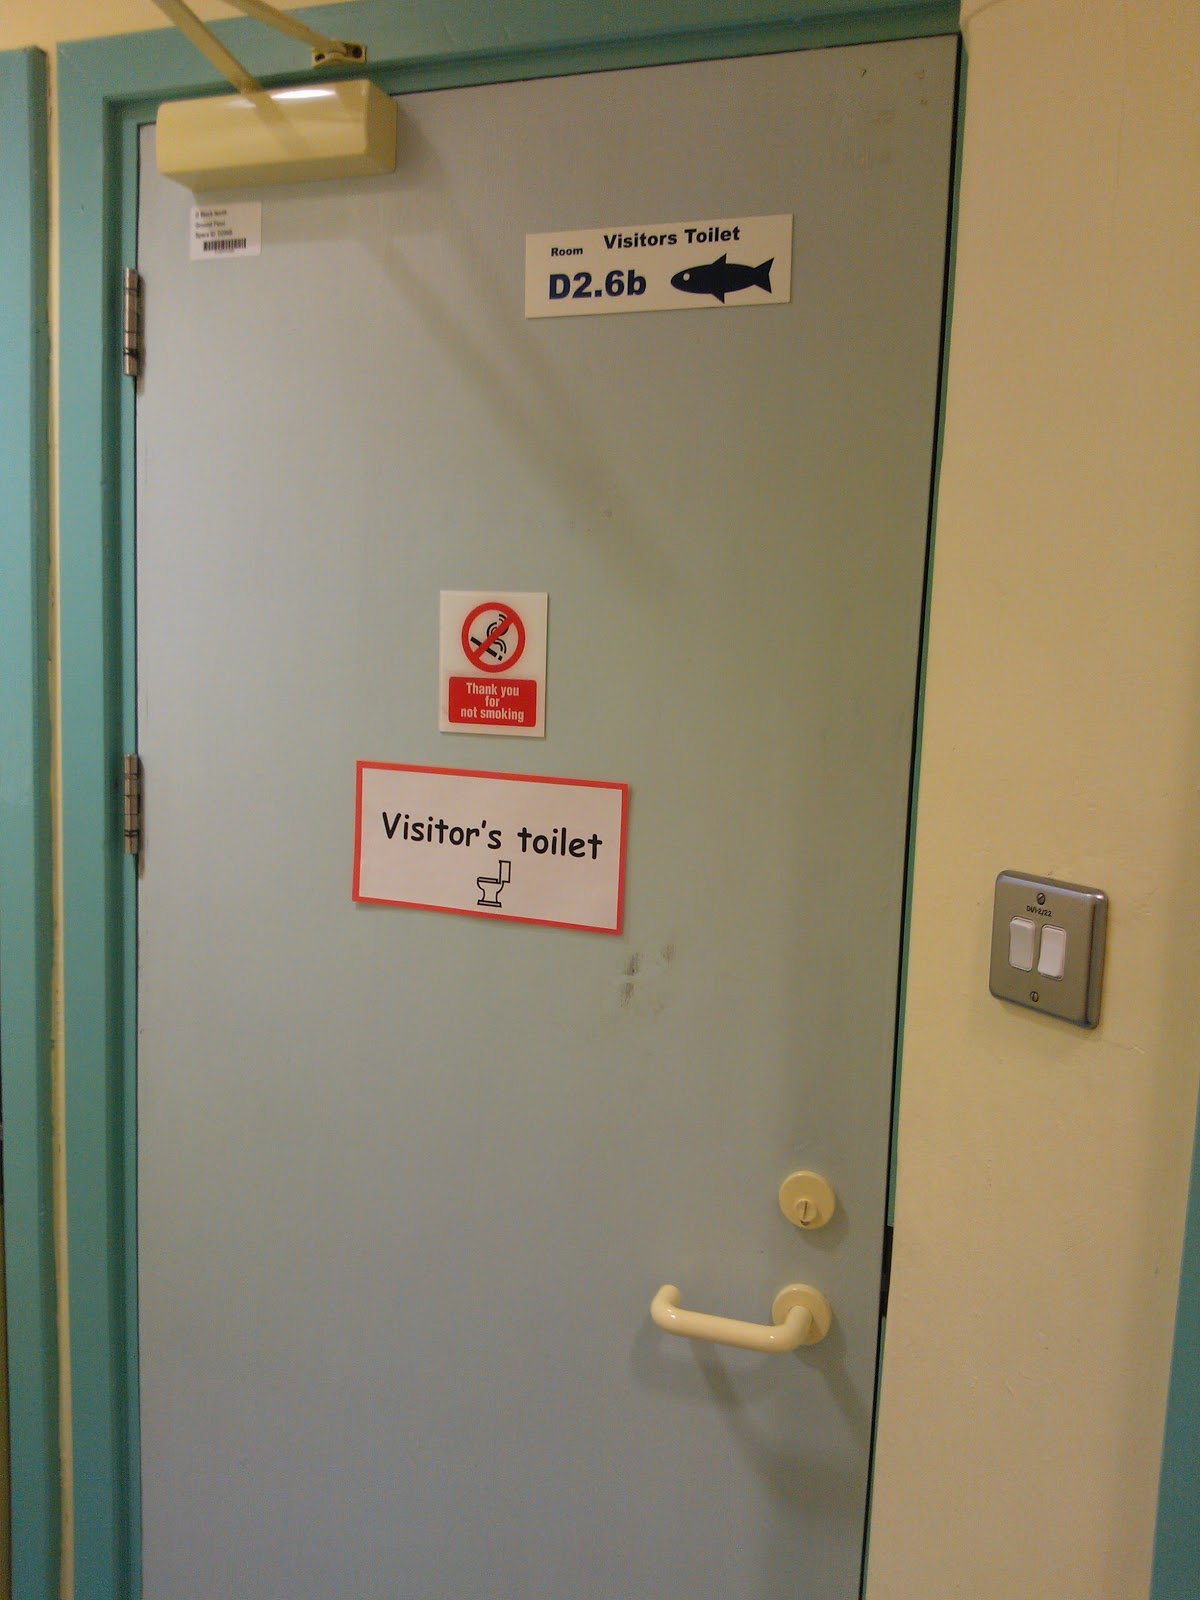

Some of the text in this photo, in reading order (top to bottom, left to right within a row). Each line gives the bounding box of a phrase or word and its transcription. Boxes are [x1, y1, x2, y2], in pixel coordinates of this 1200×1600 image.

[603, 225, 741, 249] Visitors Toilet
[550, 246, 584, 257] Room
[548, 269, 647, 300] D2.6b
[466, 682, 520, 698] Thank you
[484, 695, 500, 708] for
[460, 707, 524, 722] not smoking
[382, 811, 603, 860] Visitor's toilet
